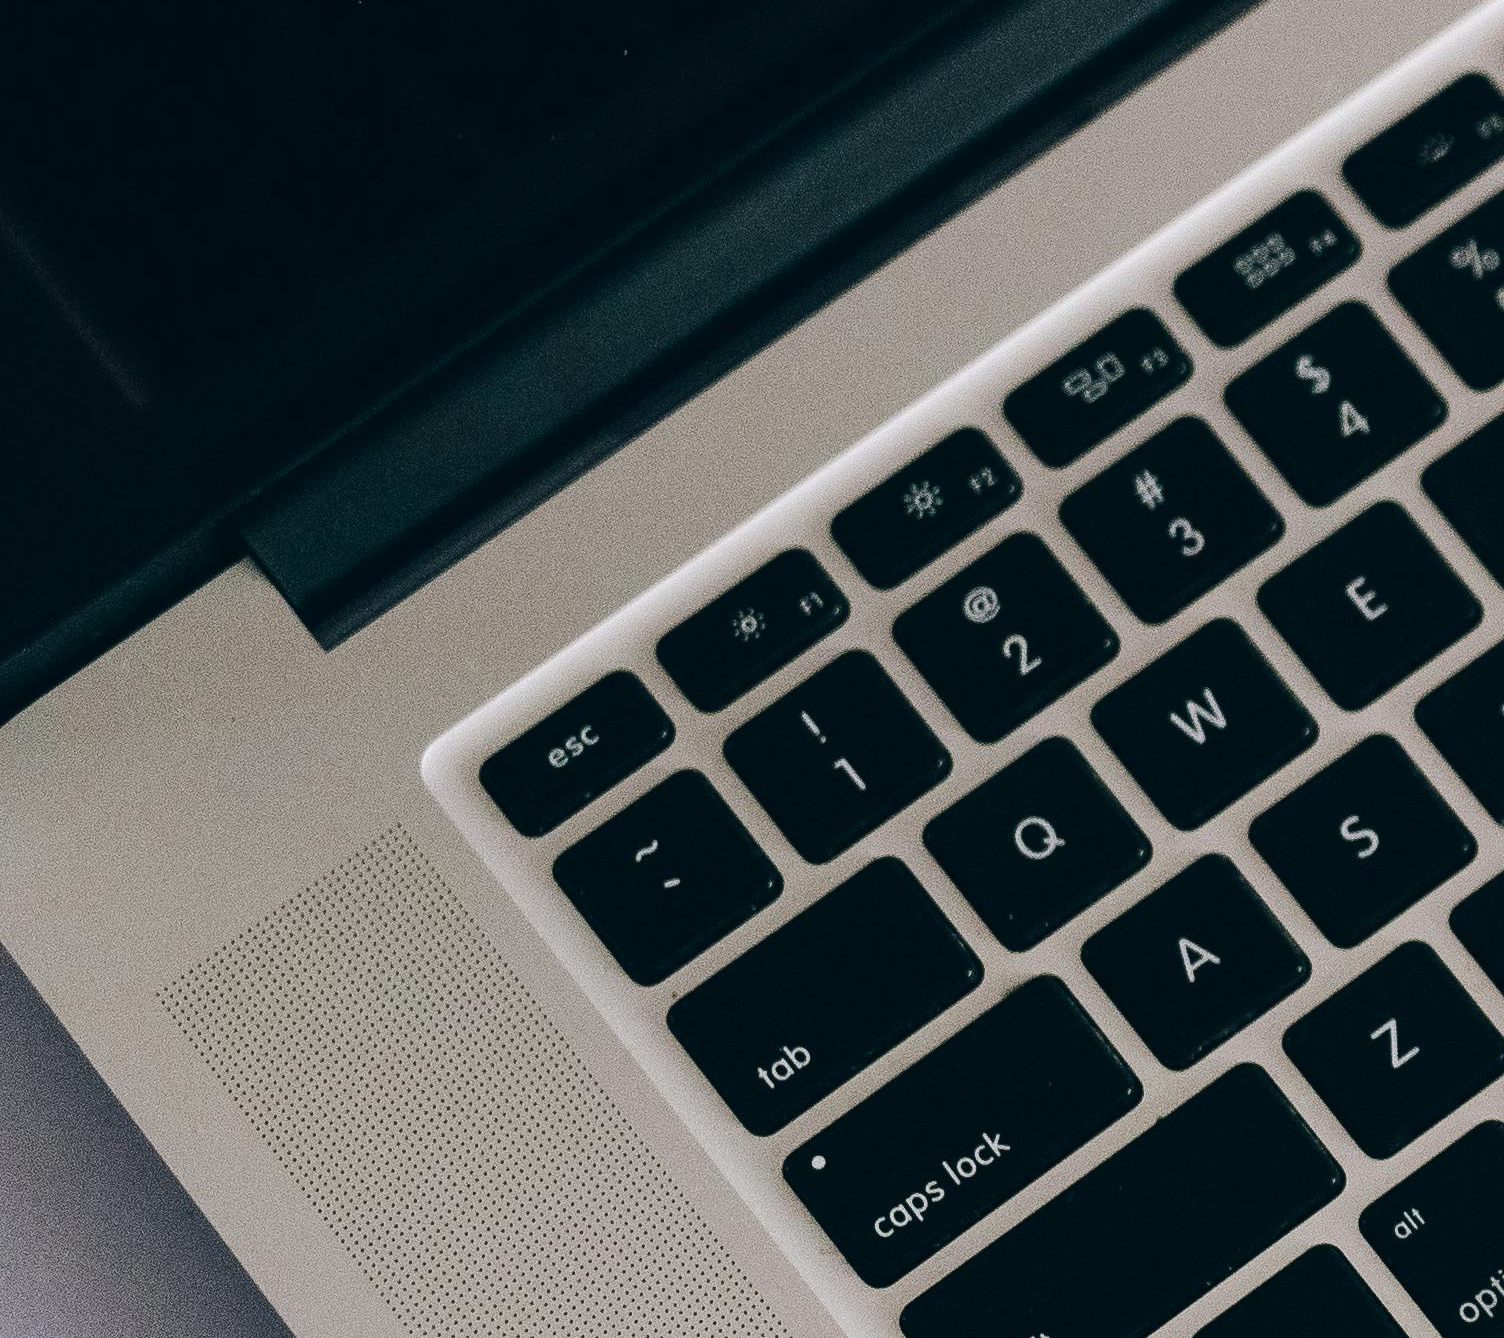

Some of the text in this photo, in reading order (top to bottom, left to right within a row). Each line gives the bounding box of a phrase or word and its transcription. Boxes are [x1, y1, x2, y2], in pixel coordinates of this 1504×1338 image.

[1296, 356, 1331, 393] $
[1339, 401, 1369, 436] 4
[969, 468, 995, 492] F2
[1135, 471, 1163, 508] #
[1168, 517, 1206, 557] 3
[799, 592, 824, 615] F1
[963, 587, 999, 623] @
[1345, 576, 1387, 621] E
[1002, 634, 1042, 676] 2
[800, 711, 827, 744] !
[1169, 688, 1227, 745] W
[547, 725, 600, 769] esc
[833, 757, 867, 791] 1
[1013, 816, 1065, 860] Q
[1339, 814, 1380, 859] S
[1177, 937, 1221, 983] A
[1370, 1018, 1420, 1069] Z
[756, 1045, 812, 1089] tab
[873, 1132, 1011, 1239] caps lock
[1393, 1207, 1426, 1240] alt
